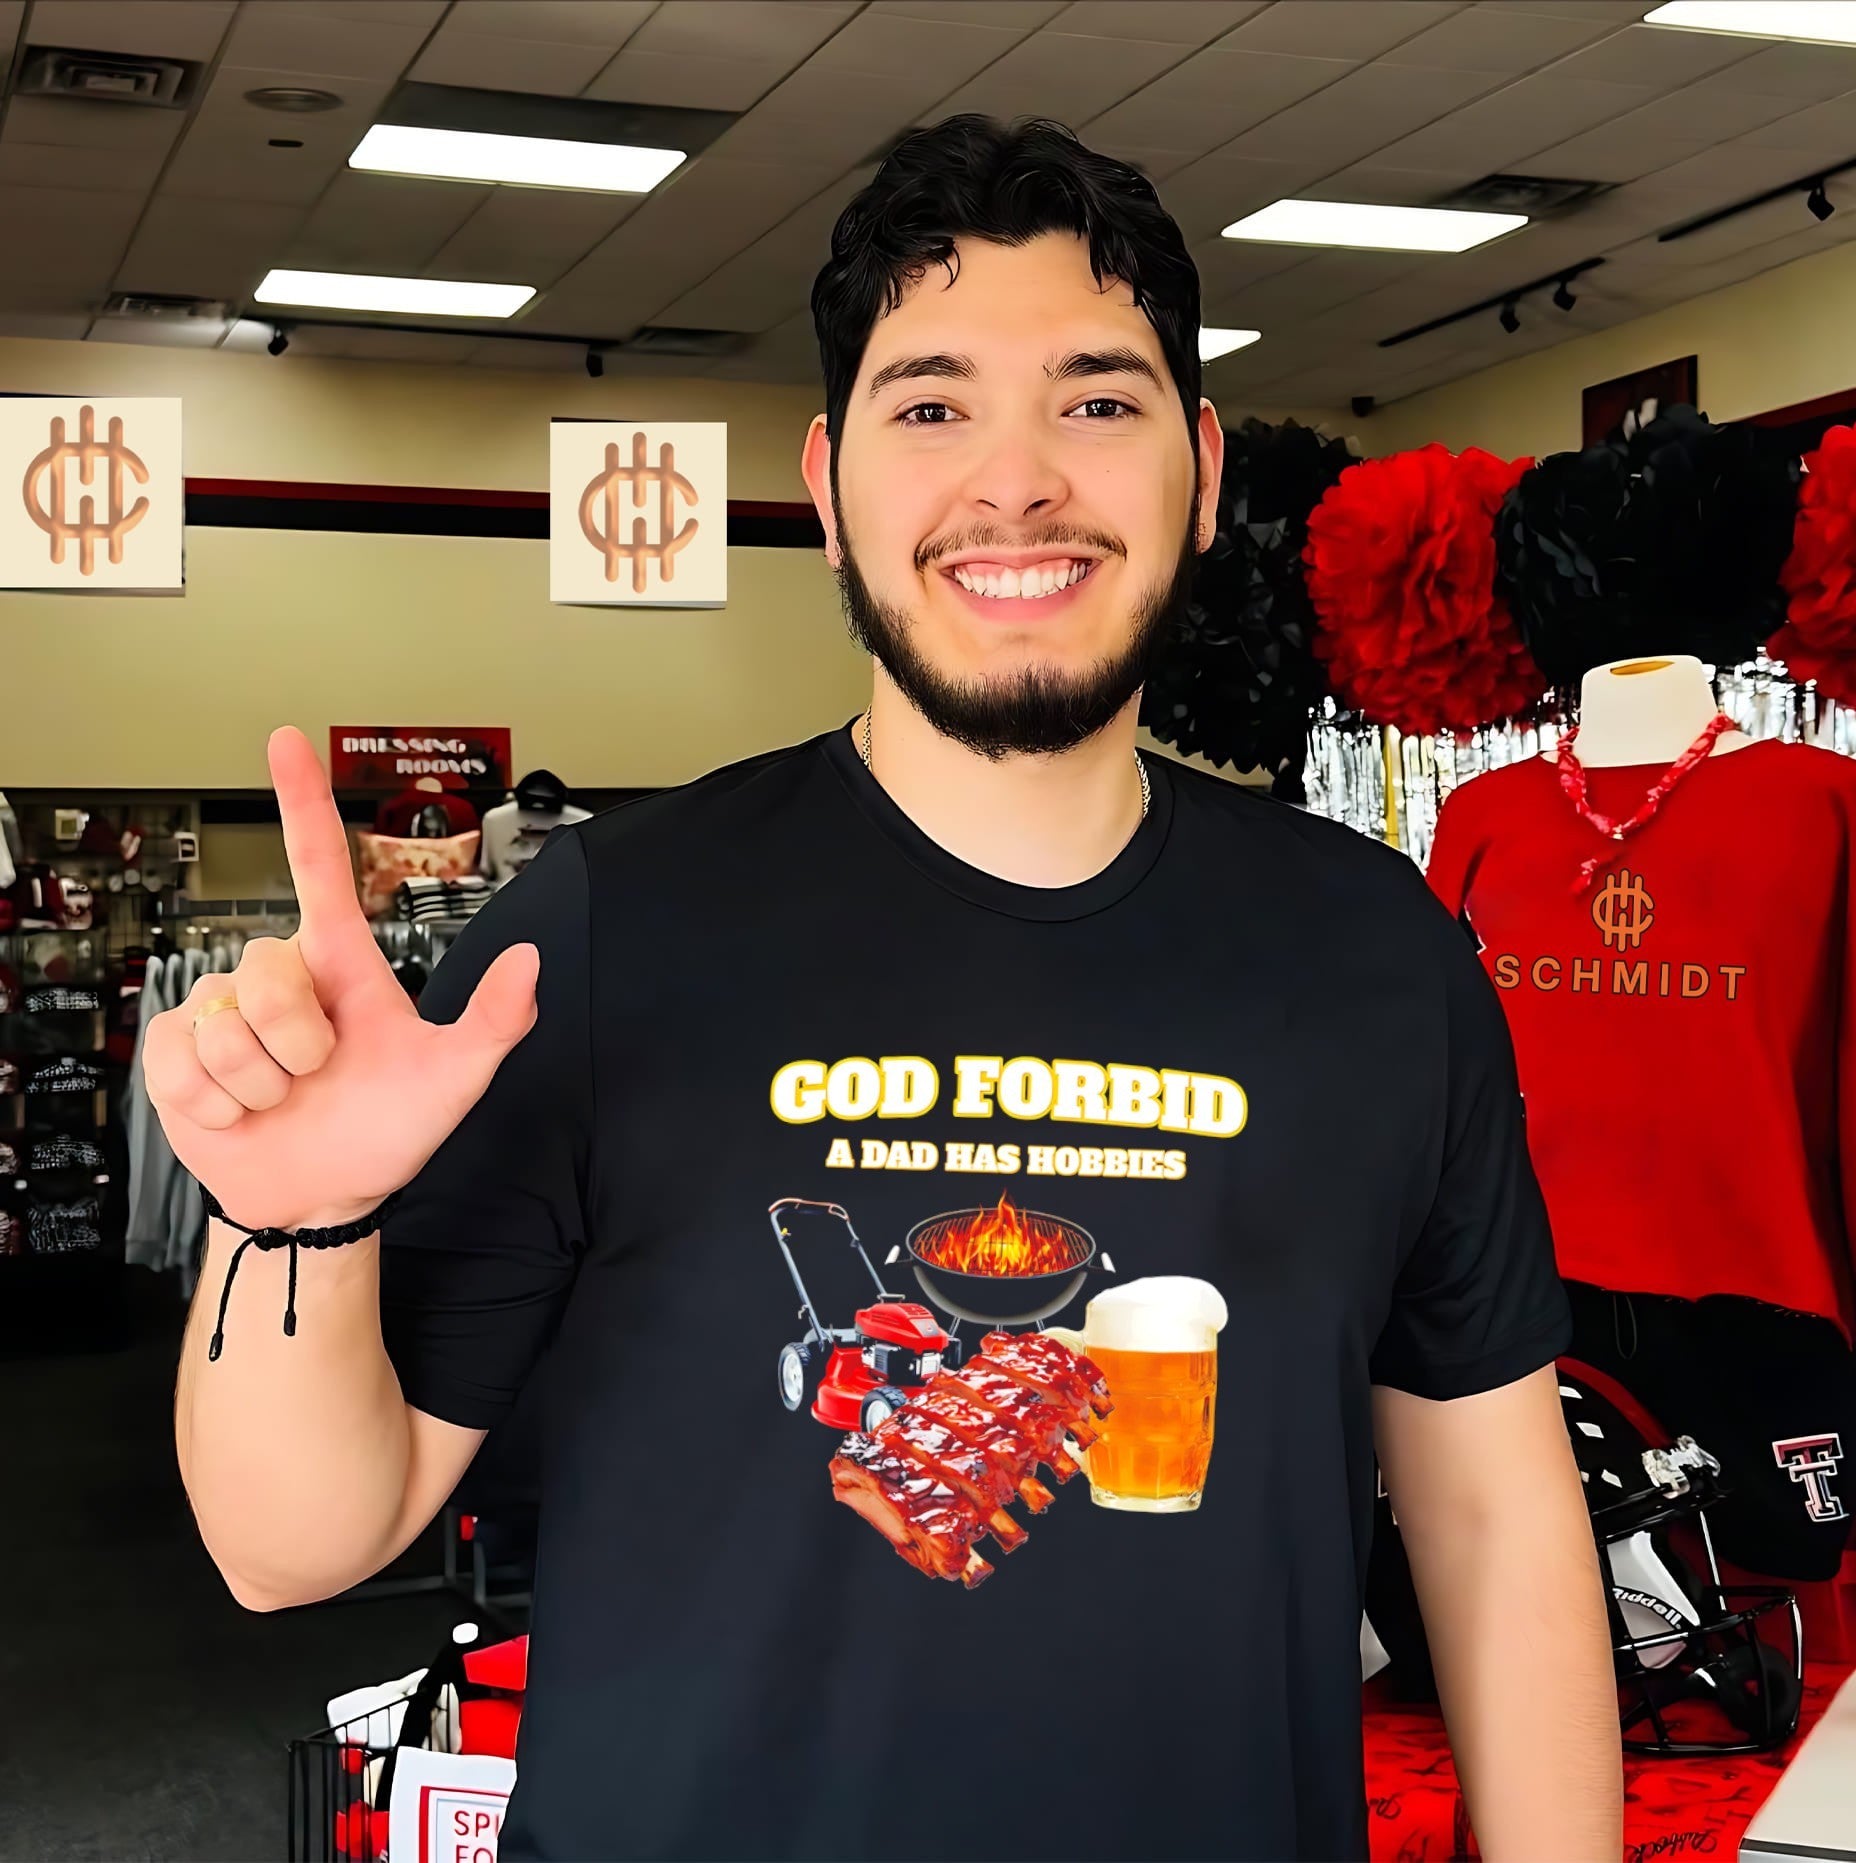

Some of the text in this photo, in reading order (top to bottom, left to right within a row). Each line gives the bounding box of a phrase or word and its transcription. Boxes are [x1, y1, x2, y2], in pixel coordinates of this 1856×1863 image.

[342, 737, 467, 754] DRESSING
[396, 758, 487, 775] ROOMS
[1494, 953, 1747, 1000] SCHMIDT
[770, 1056, 1248, 1138] GOD FORBID
[825, 1138, 1187, 1180] A DAD HAS HOBBIES
